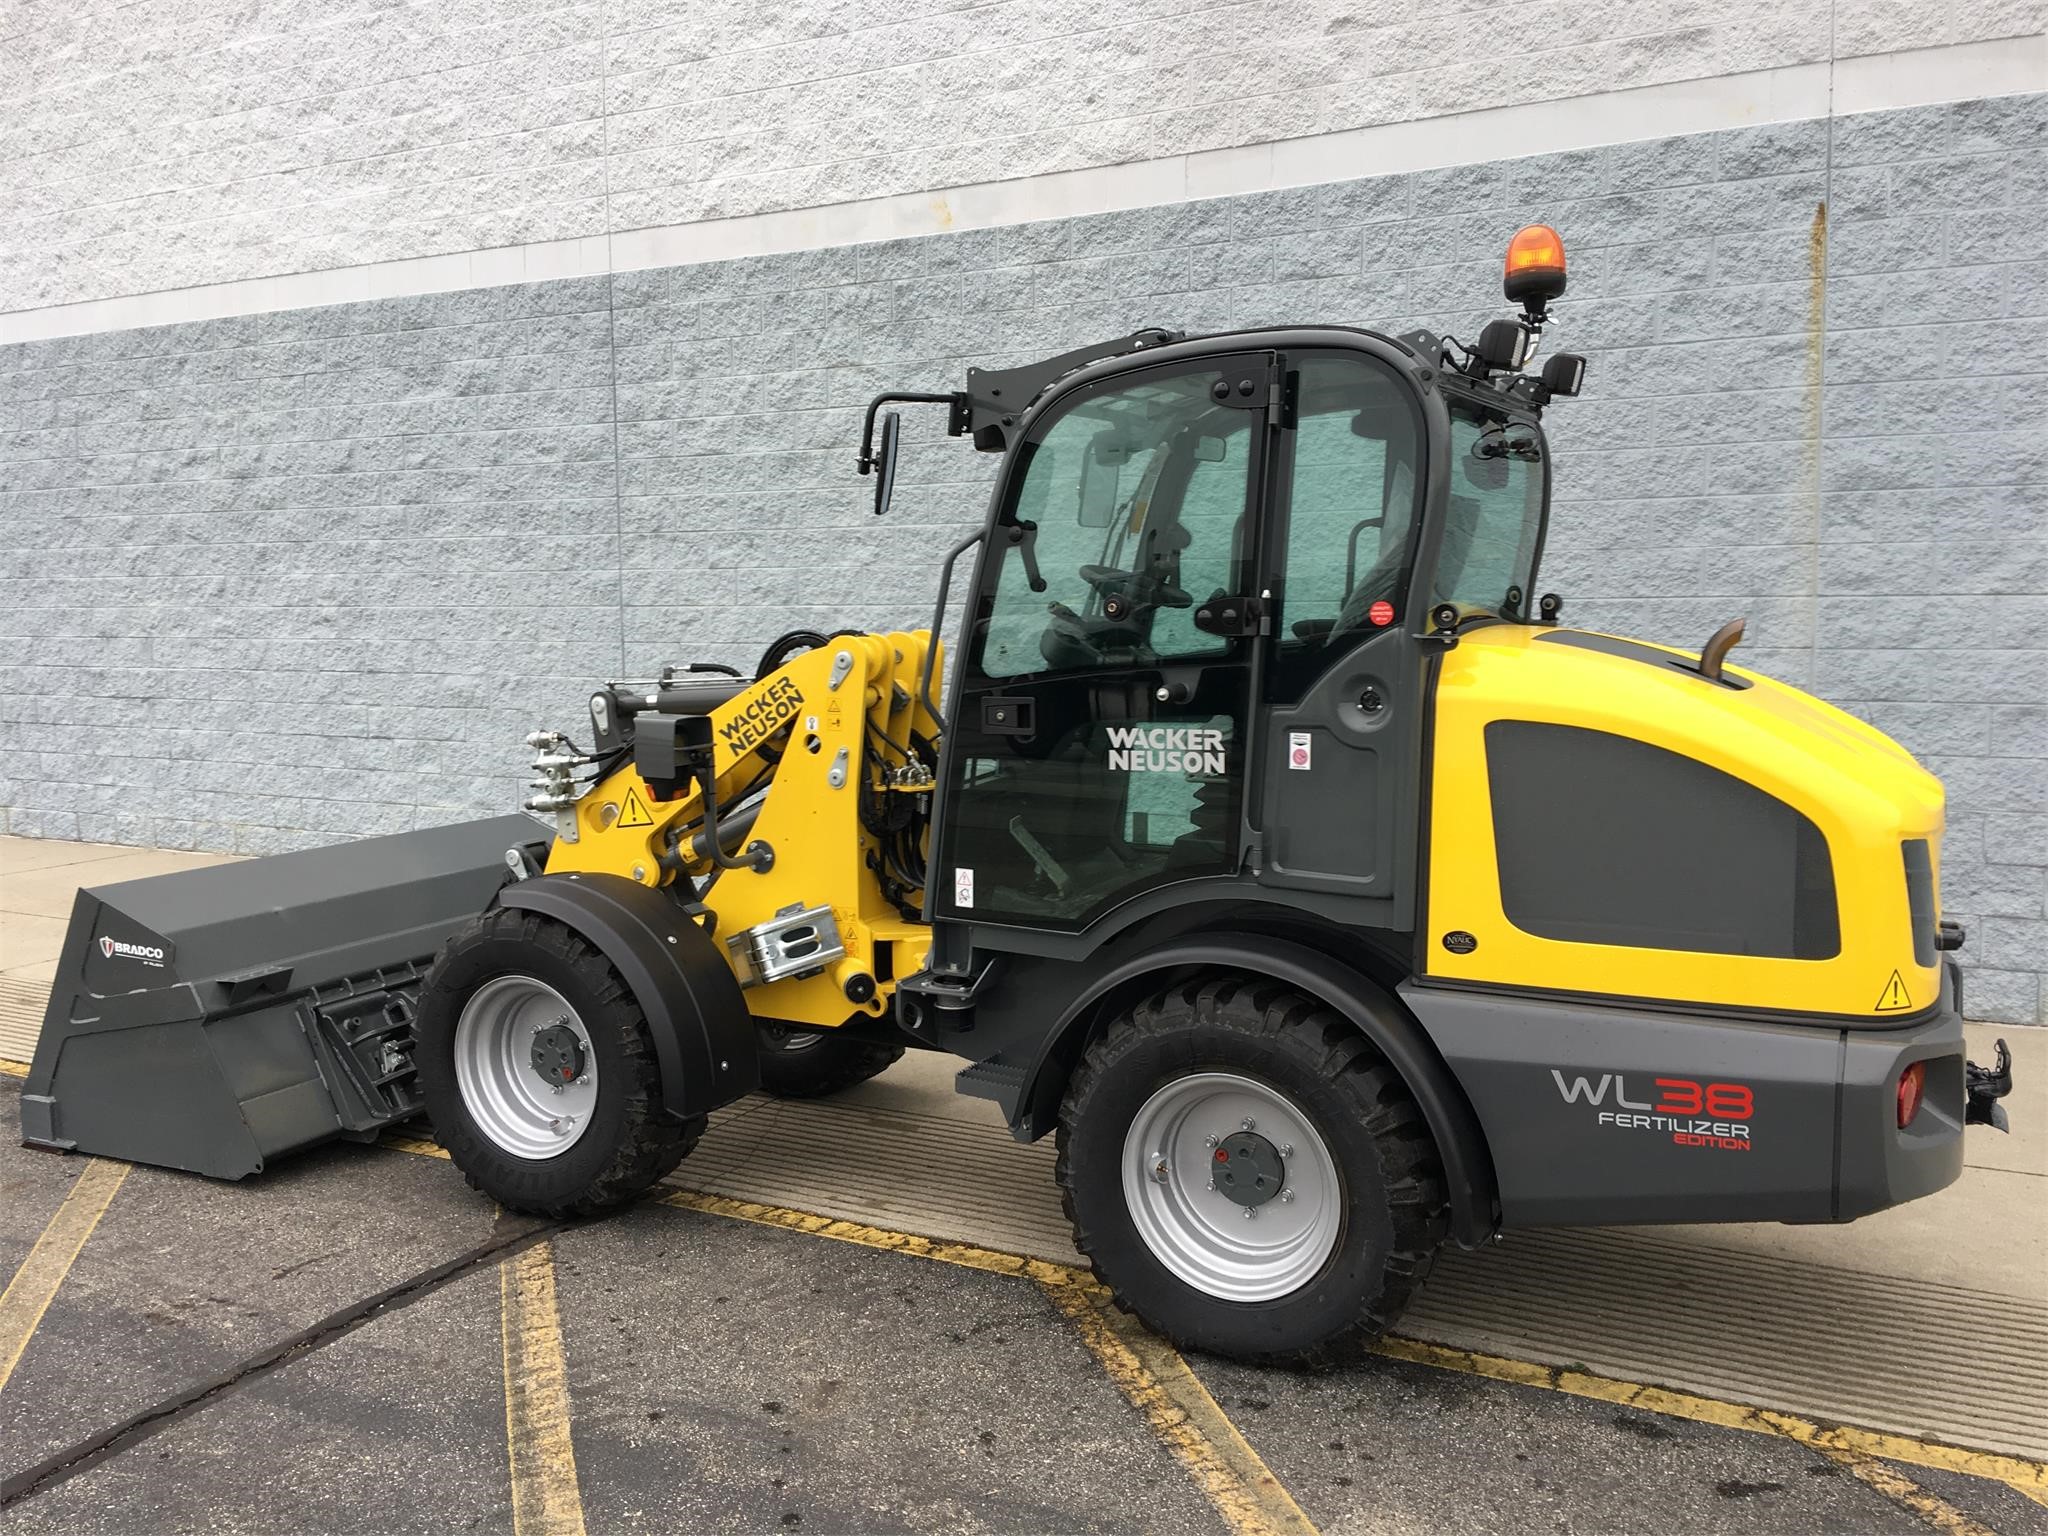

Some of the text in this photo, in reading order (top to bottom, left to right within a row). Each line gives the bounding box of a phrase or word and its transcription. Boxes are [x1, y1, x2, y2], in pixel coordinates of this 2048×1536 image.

[719, 676, 796, 740] WACKER
[729, 689, 805, 757] NEUSON
[1105, 727, 1226, 750] WACKER
[1107, 750, 1227, 773] NEUSON
[114, 942, 164, 959] BRADCO
[1550, 1069, 1754, 1120] WL38
[1598, 1112, 1750, 1139] FERTILIZER
[1673, 1133, 1751, 1151] EDITION
